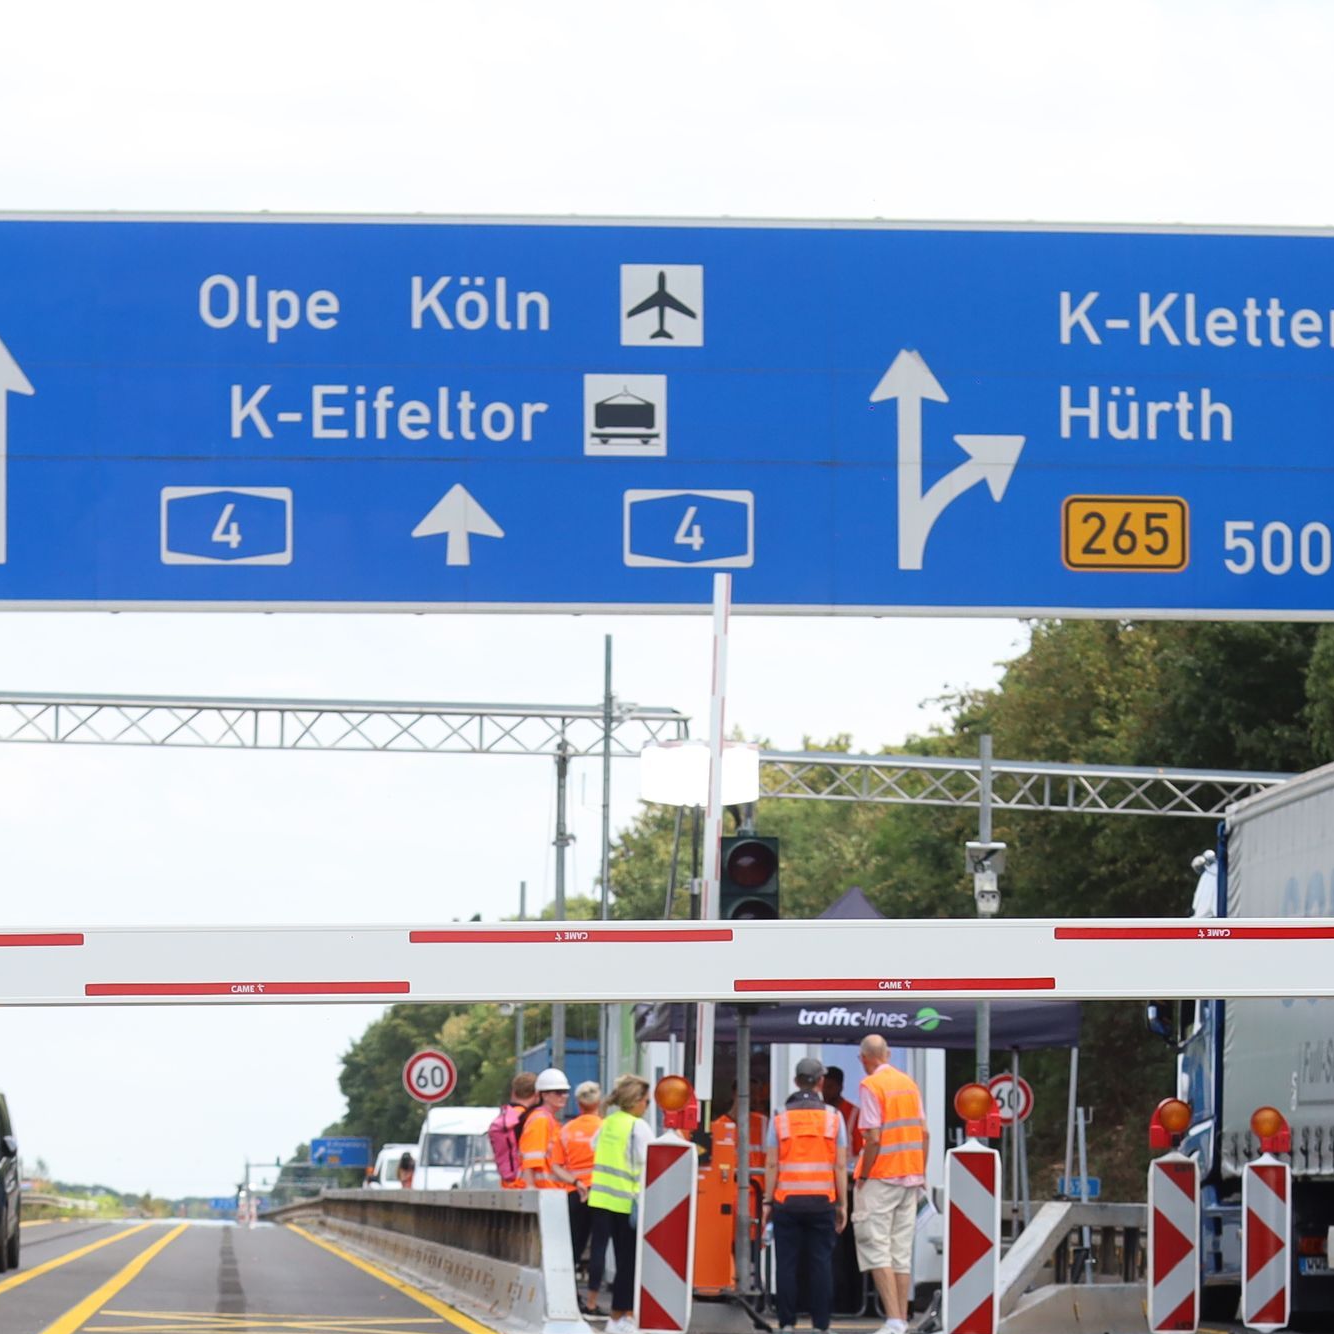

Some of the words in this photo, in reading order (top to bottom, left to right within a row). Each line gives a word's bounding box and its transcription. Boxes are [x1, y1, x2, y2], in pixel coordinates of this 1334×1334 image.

[199, 275, 340, 343] Olpe
[411, 276, 551, 331] Köln
[229, 384, 549, 442] K-Eifeltor
[1059, 386, 1234, 441] Hürth
[211, 503, 243, 550] 4
[673, 505, 705, 552] 4
[1080, 512, 1170, 556] 265
[1224, 522, 1331, 577] 500
[564, 931, 589, 940] CAME
[1206, 929, 1231, 937] CAME
[230, 985, 255, 993] CAME
[877, 981, 903, 989] CAME
[415, 1065, 444, 1089] 60
[995, 1088, 1021, 1110] 60
